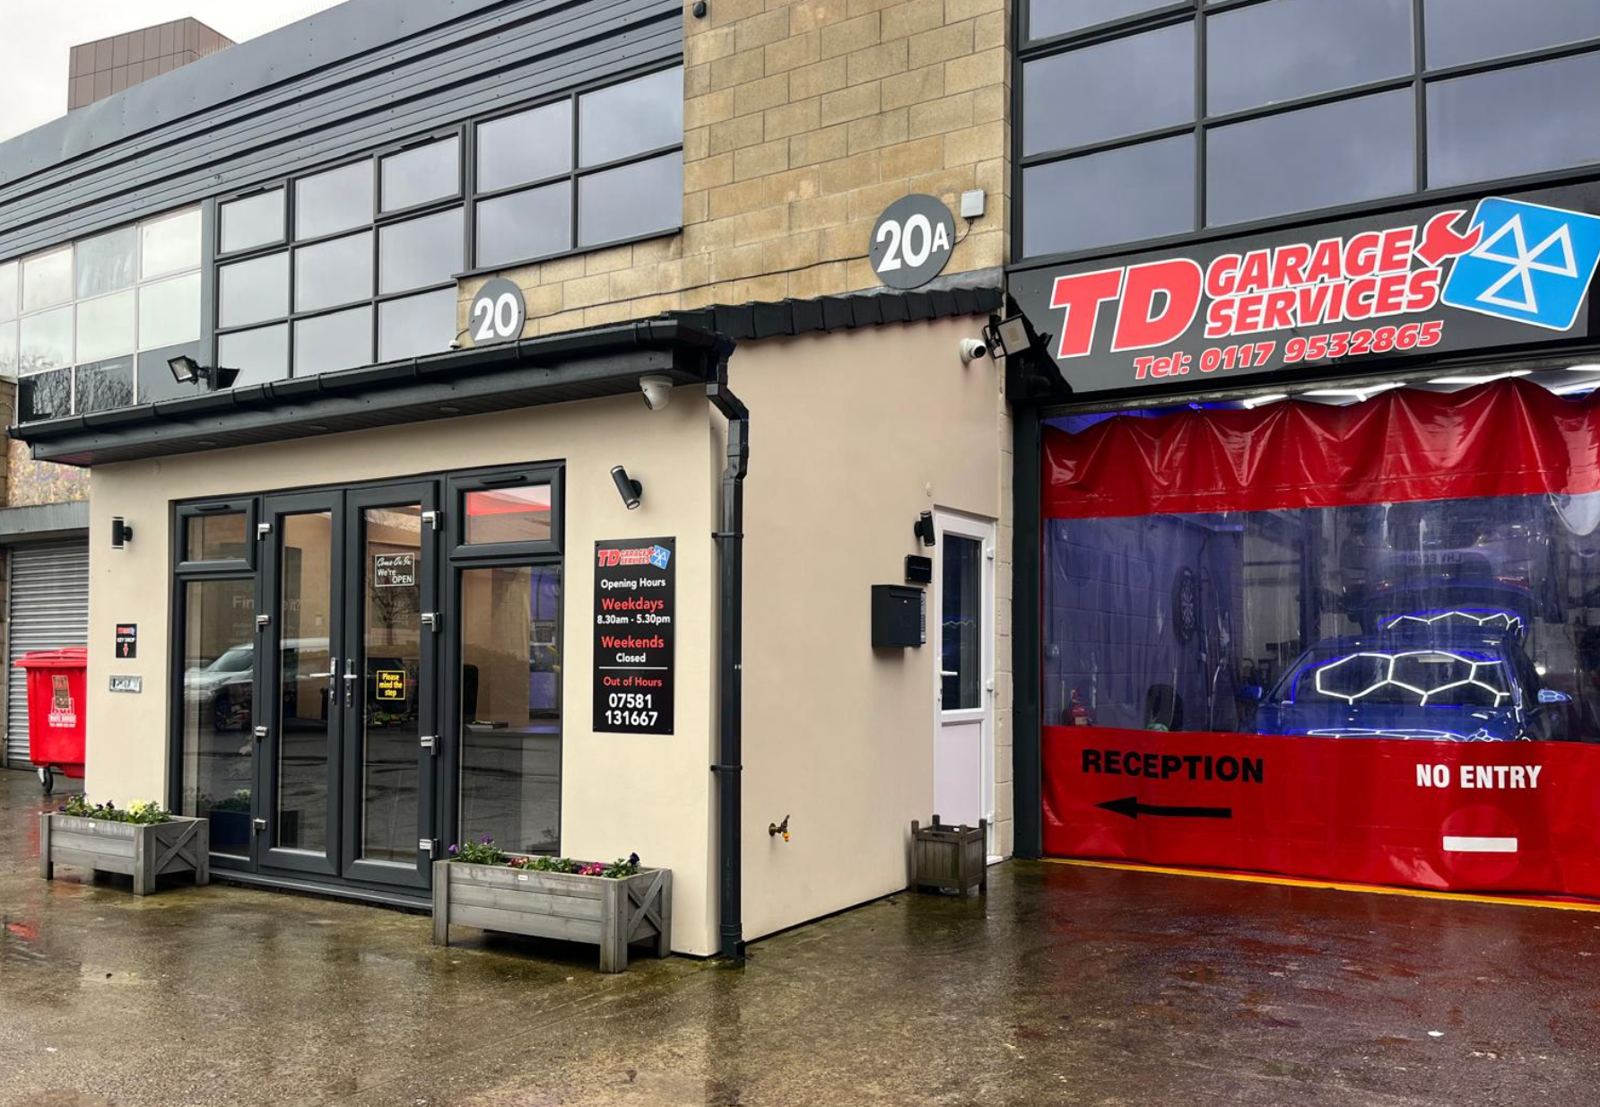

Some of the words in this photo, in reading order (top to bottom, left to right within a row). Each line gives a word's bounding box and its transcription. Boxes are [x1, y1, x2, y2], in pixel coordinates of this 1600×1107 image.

[876, 213, 950, 273] 20A
[1204, 225, 1418, 299] GARAGE
[1049, 258, 1204, 359] TD
[1204, 267, 1443, 338] SERVICES
[474, 292, 519, 341] 20
[1133, 351, 1190, 380] Tel:
[1200, 341, 1276, 373] 0117
[1284, 321, 1444, 362] 9532865
[598, 549, 621, 567] TD
[392, 575, 412, 584] OPEN
[600, 578, 637, 590] Opening
[639, 577, 666, 587] Hours
[601, 596, 664, 613] Weekdays
[597, 614, 629, 624] 8.30am
[636, 613, 671, 626] 5.30pm
[601, 635, 665, 648] Weekends
[615, 652, 646, 662] Closed
[603, 676, 620, 686] Out
[623, 676, 633, 686] of
[635, 676, 662, 687] Hours
[608, 693, 652, 709] 07581
[605, 710, 658, 726] 131667
[1082, 750, 1263, 784] RECEPTION
[1416, 764, 1450, 788] NO
[1460, 765, 1542, 789] ENTRY
